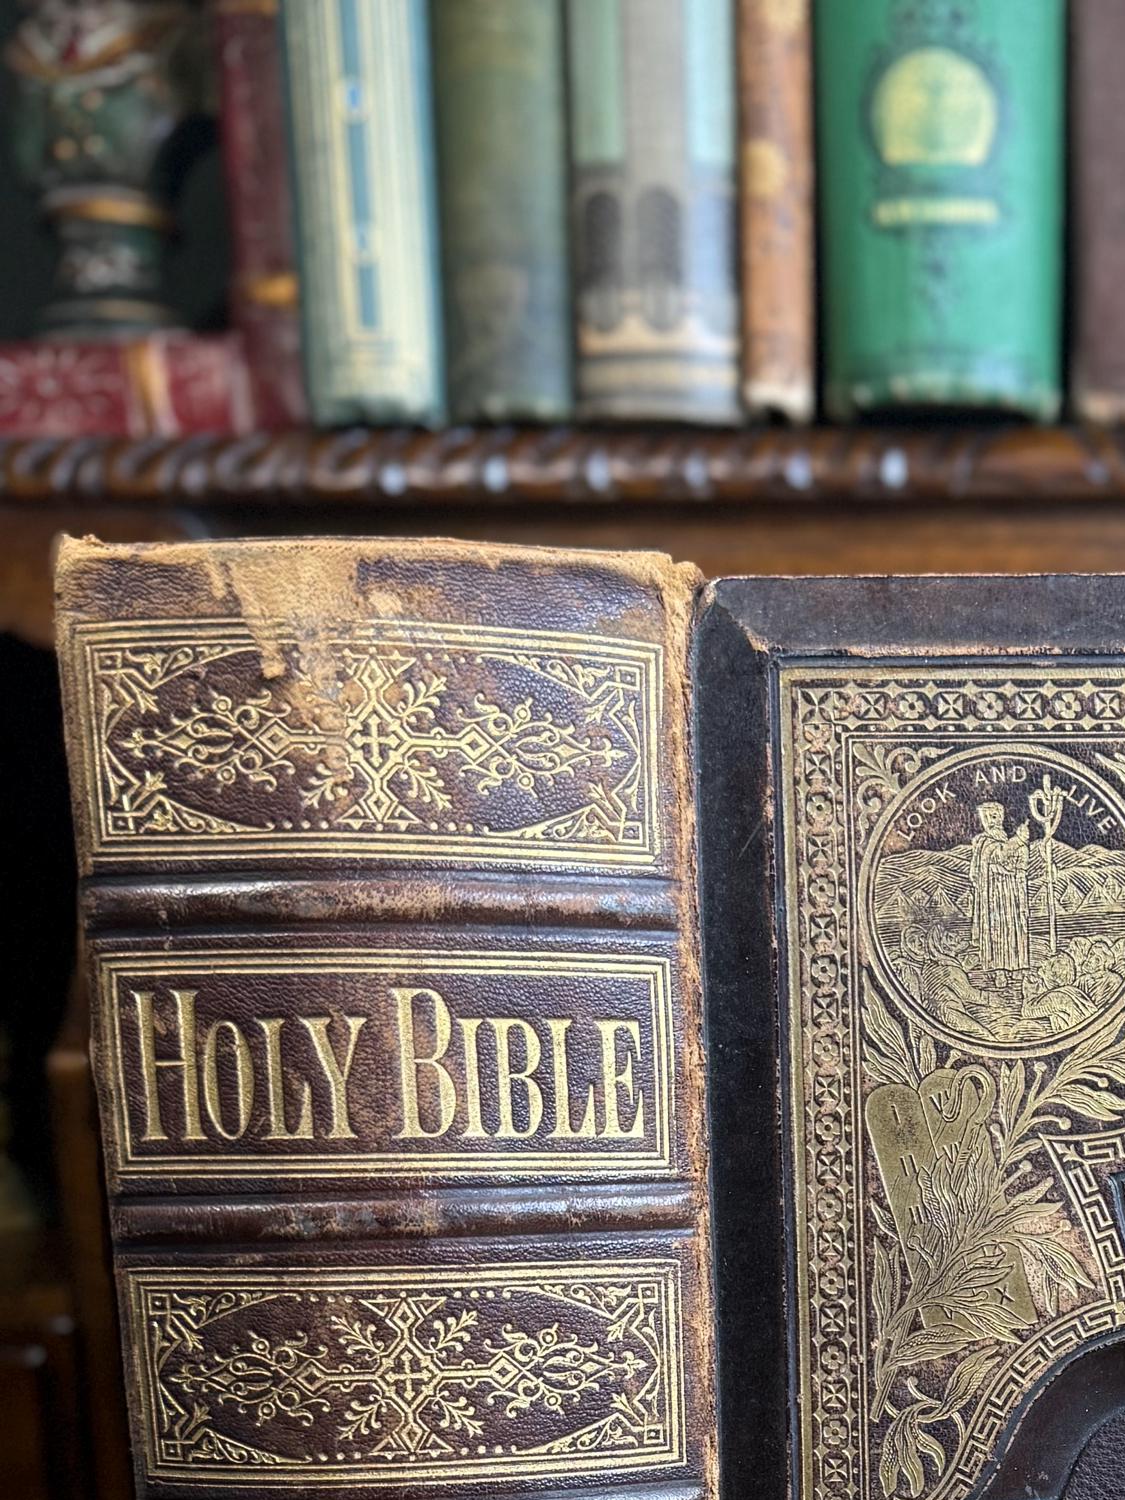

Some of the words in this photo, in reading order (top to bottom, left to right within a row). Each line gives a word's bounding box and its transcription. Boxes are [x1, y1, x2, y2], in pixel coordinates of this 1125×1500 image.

[897, 782, 956, 841] LOOK
[974, 765, 1028, 788] AND
[1065, 784, 1118, 835] LIVE
[131, 987, 369, 1142] HOLY
[390, 985, 647, 1140] BIBLE
